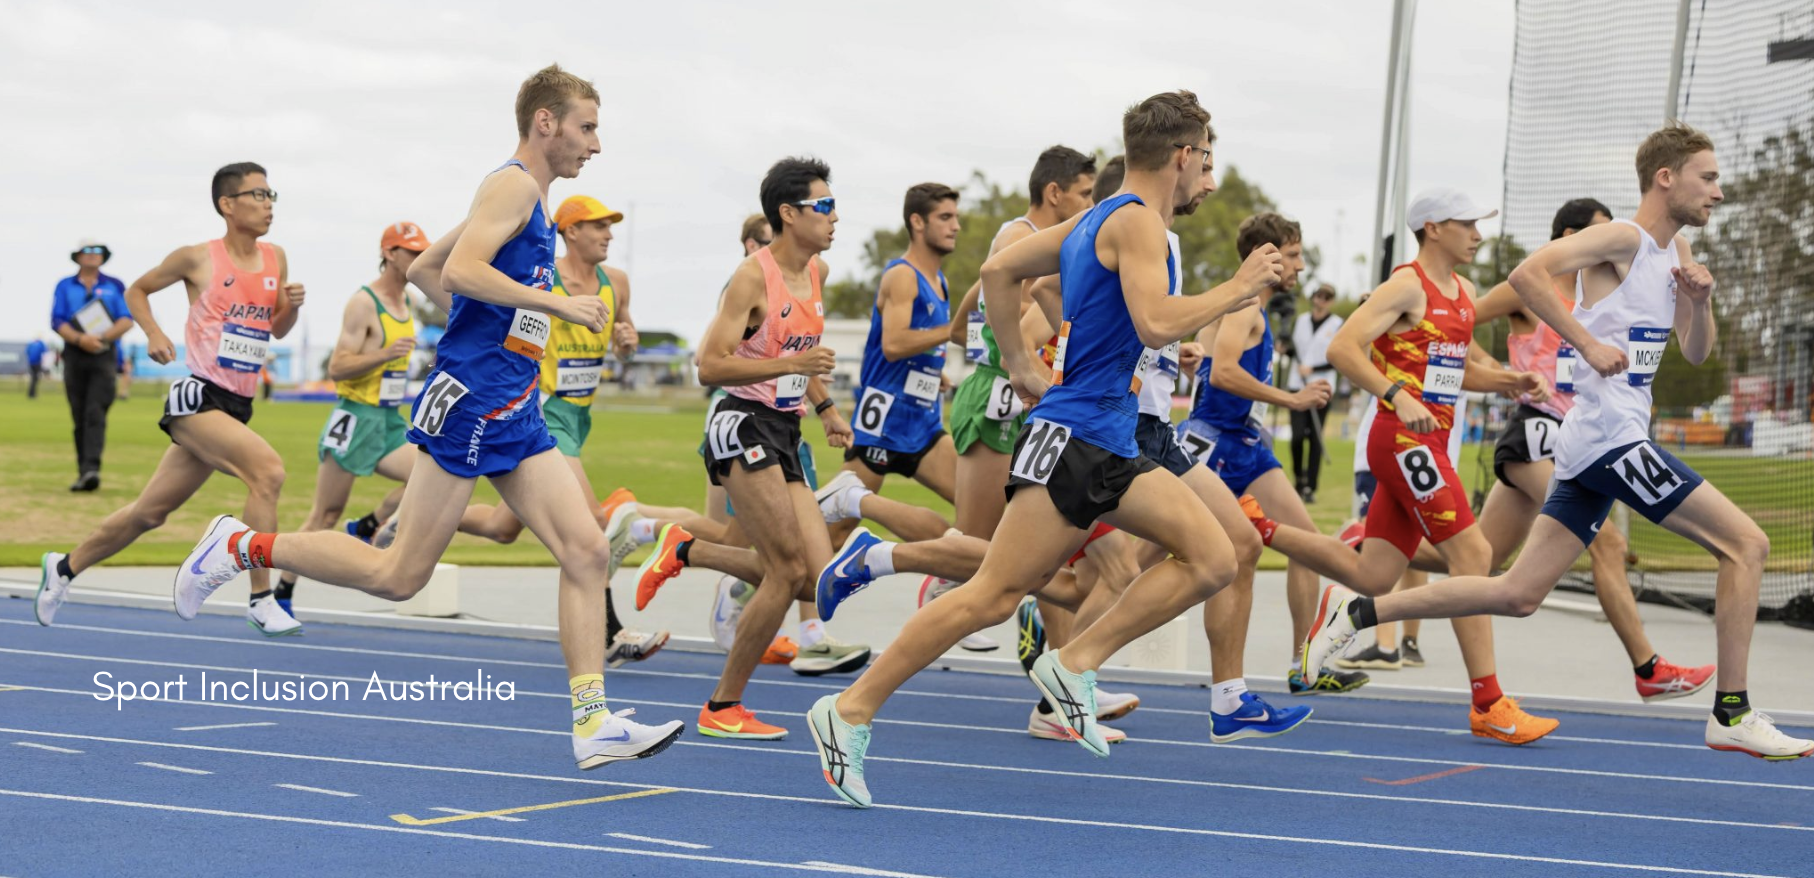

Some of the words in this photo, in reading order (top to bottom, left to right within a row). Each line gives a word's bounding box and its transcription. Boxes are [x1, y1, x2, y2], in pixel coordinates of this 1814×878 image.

[224, 303, 273, 321] JAPAN
[557, 343, 605, 354] AUSTRALIA
[172, 380, 199, 413] 10
[420, 377, 466, 435] 15
[860, 392, 887, 431] 6
[997, 384, 1014, 418] 9
[328, 413, 351, 446] 4
[466, 417, 487, 466] FRANCE
[714, 414, 740, 455] 12
[1185, 433, 1211, 458] 7
[1535, 420, 1553, 457] 2
[866, 446, 888, 461] ITA
[1018, 421, 1068, 481] 16
[1403, 449, 1438, 492] 8
[1622, 446, 1678, 500] 14
